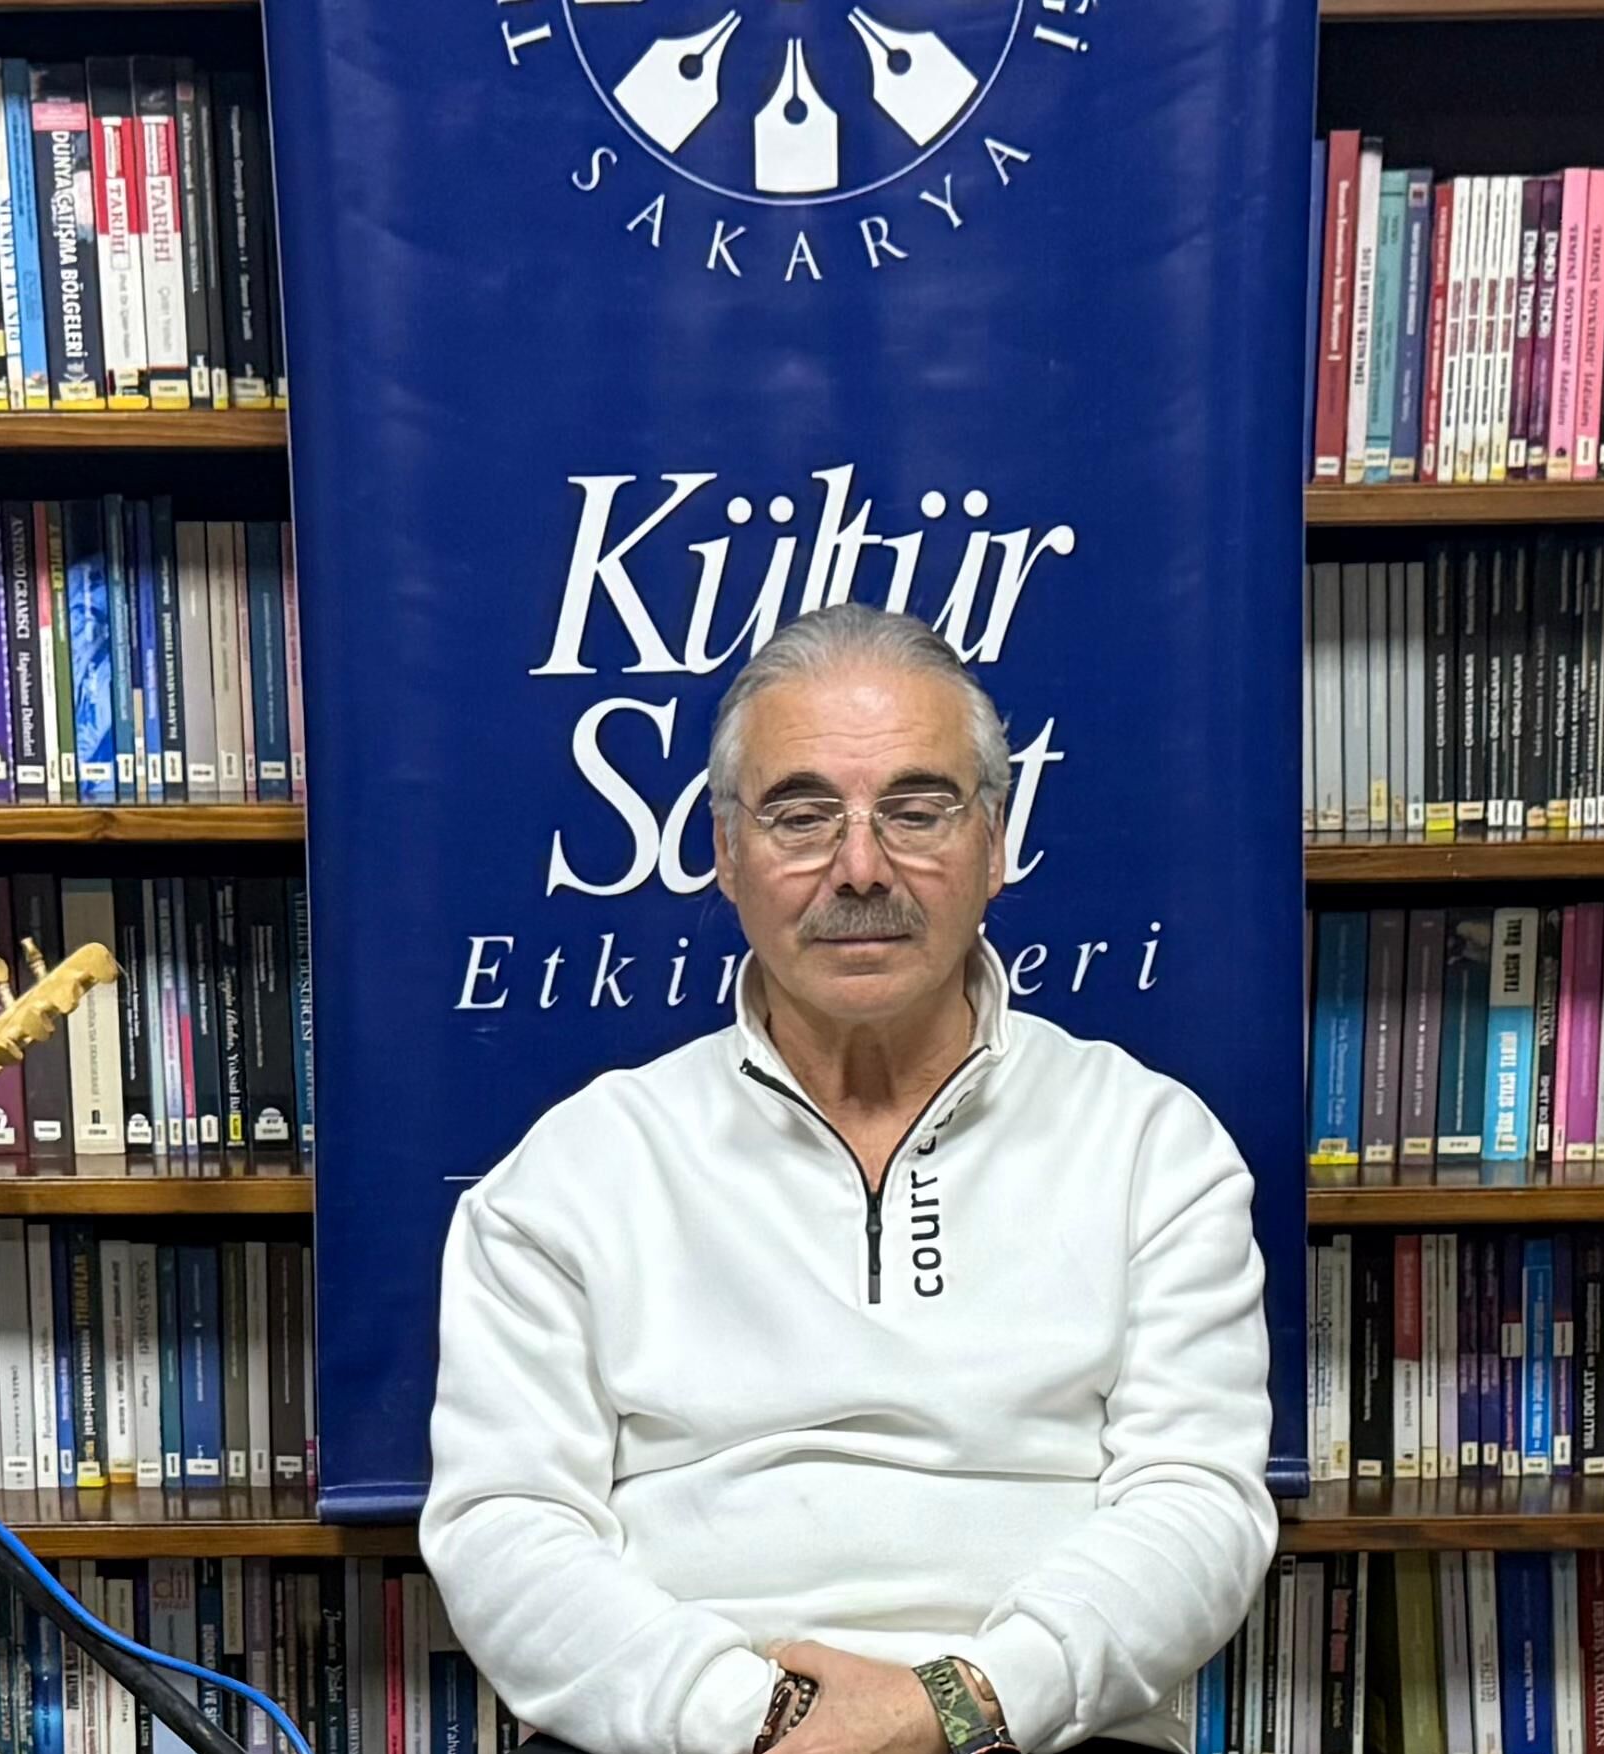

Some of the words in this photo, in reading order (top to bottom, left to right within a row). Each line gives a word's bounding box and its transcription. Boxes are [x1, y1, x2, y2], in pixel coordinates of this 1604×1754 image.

[51, 131, 76, 188] DÜNYA
[51, 189, 78, 264] ÇATIŞMA
[108, 184, 129, 255] TARİHİ
[150, 180, 172, 263] TARİHİ
[571, 131, 1031, 281] SAKARYA
[60, 269, 89, 358] BÖLGELERİ
[528, 463, 1075, 677] Kültür
[15, 579, 31, 639] GRAMSCI
[17, 651, 31, 706] Hapishane
[22, 707, 37, 757] Defterleri
[134, 1303, 152, 1355] Siyaseti
[80, 1375, 98, 1436] jean-jacques
[1584, 1371, 1596, 1416] DEVLET
[152, 1574, 192, 1600] dil
